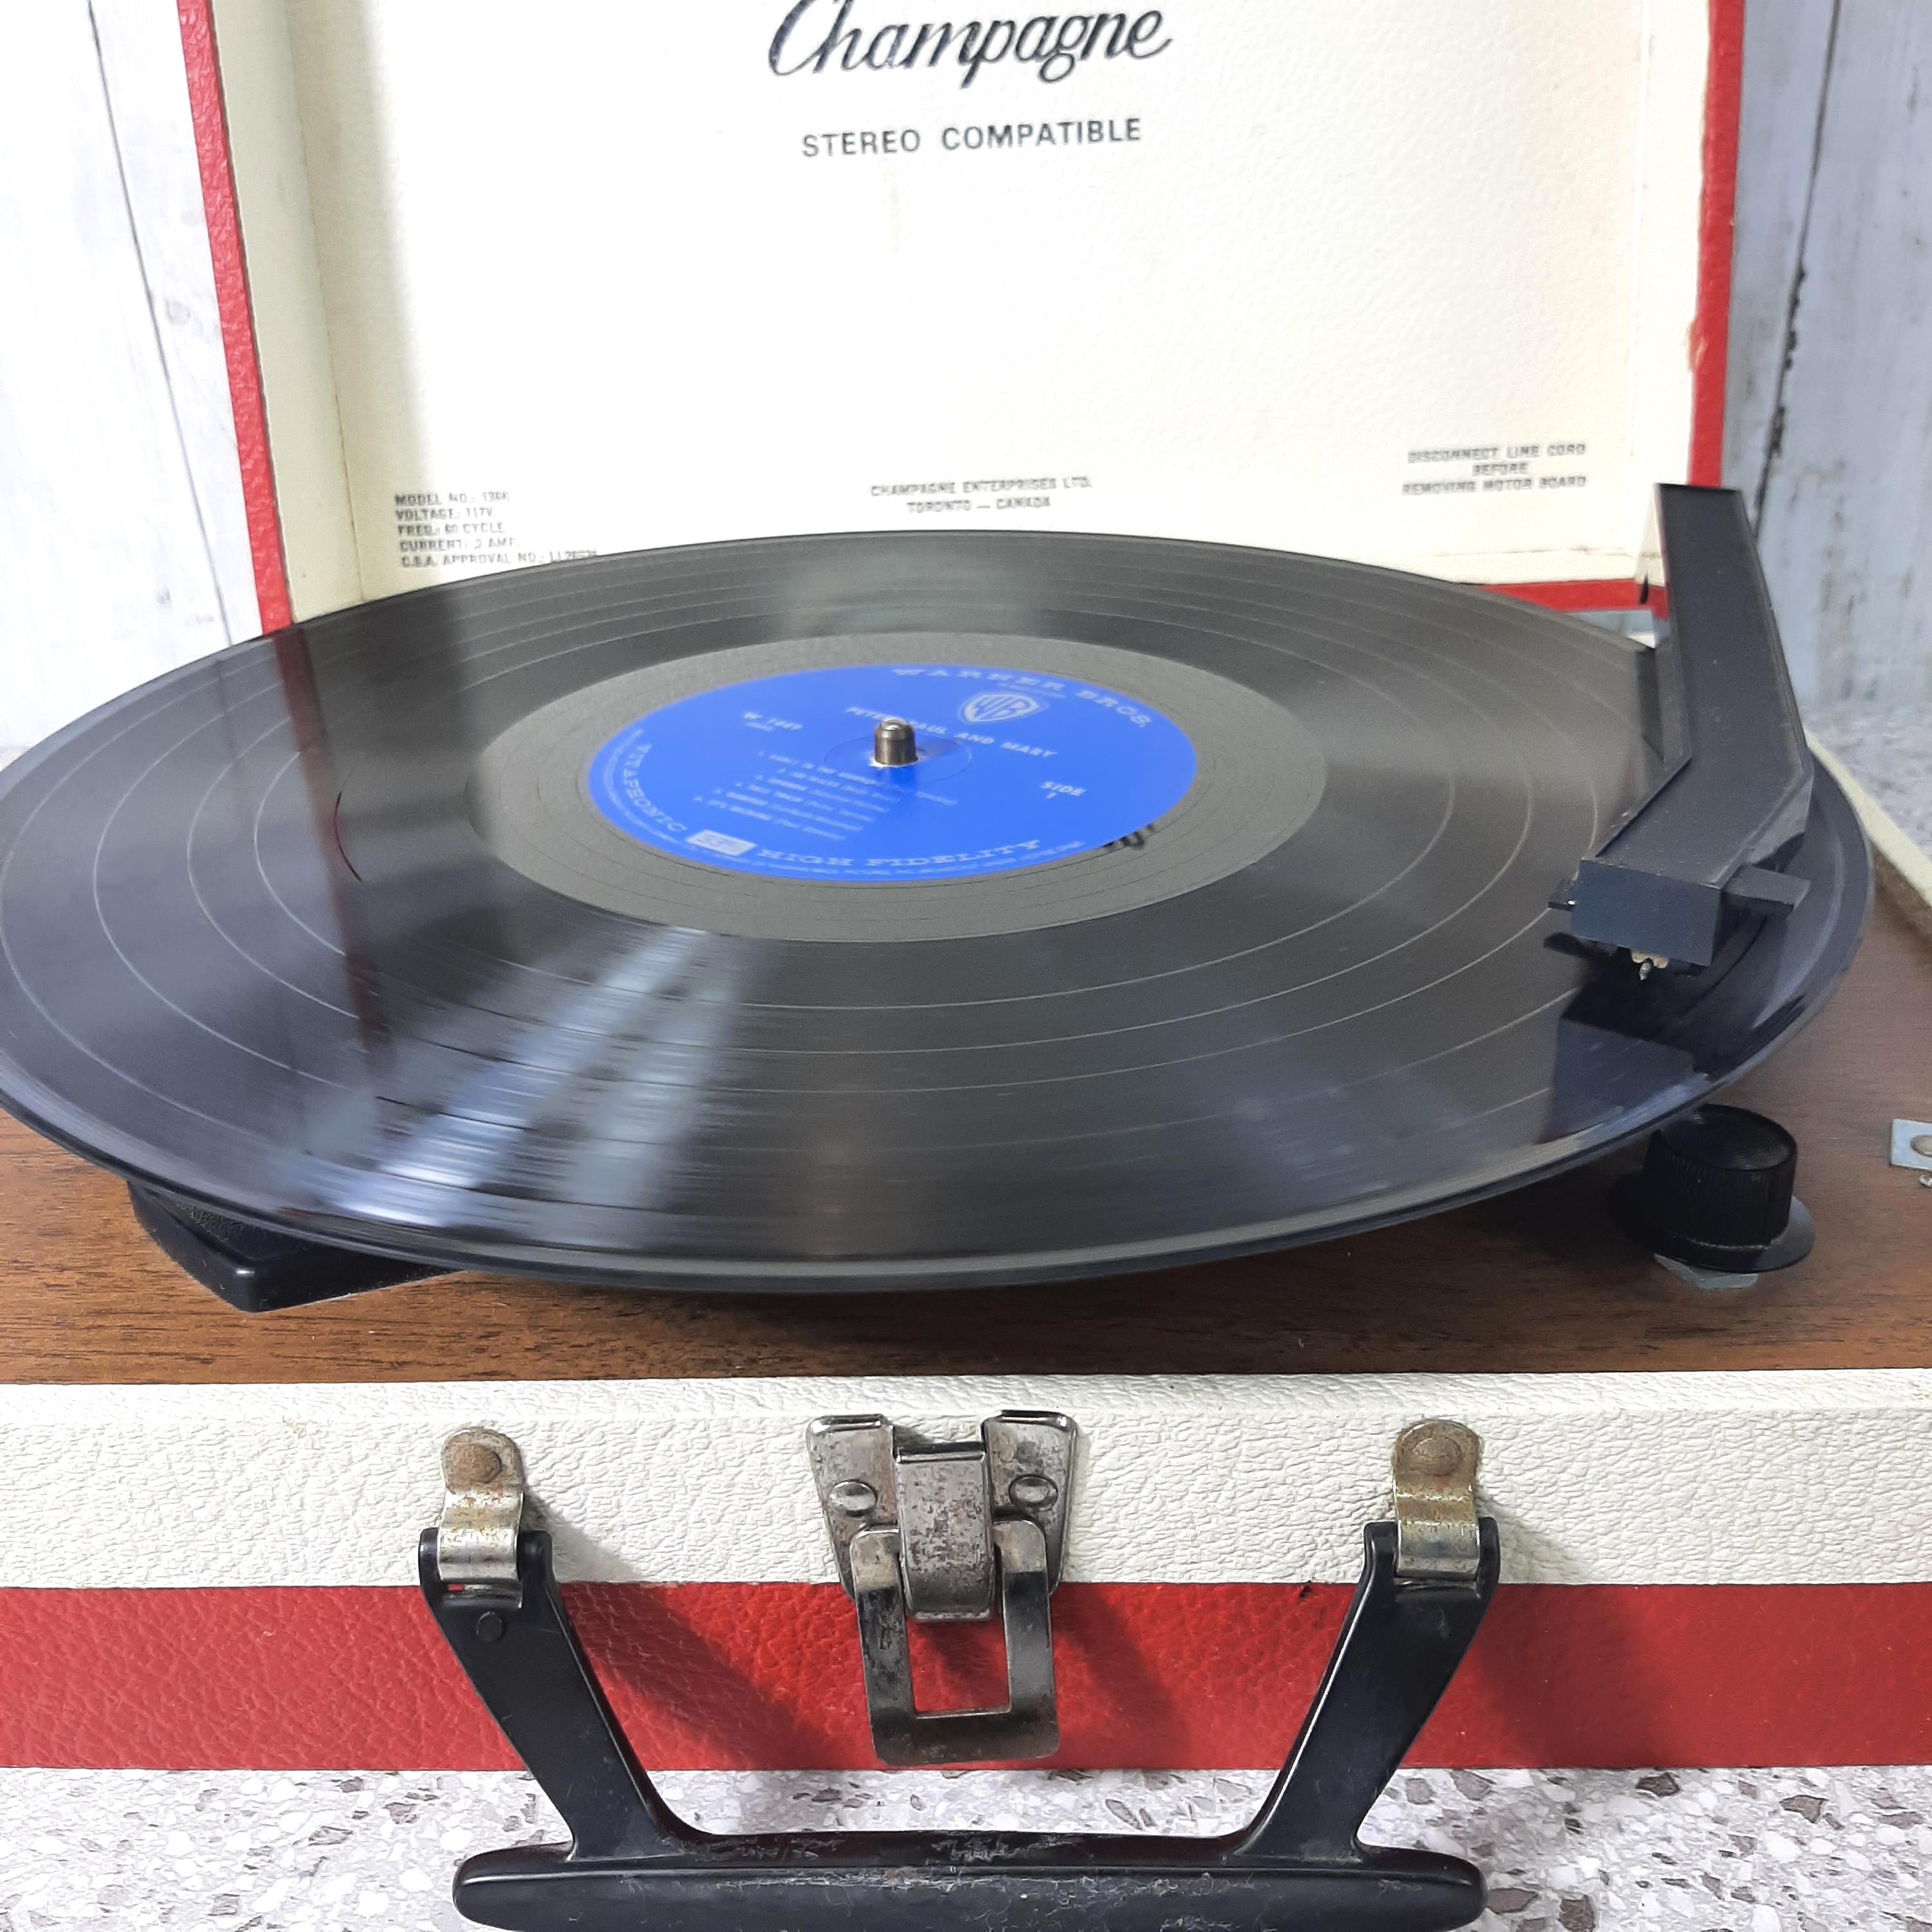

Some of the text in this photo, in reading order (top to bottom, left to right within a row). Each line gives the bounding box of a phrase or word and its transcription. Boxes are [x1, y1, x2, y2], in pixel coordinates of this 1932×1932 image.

[768, 0, 1172, 89] Champagne
[802, 118, 1142, 158] STEREO COMPATIBLE
[1408, 447, 1498, 464] DISCONNECT
[1547, 442, 1586, 457] CORD
[1473, 462, 1528, 477] BEFORE
[1402, 476, 1586, 495] REMOVING MOTOR BOARD
[394, 493, 442, 507] MODEL
[463, 522, 506, 534] CYCLE
[443, 552, 511, 565] APPROVAL
[892, 668, 1066, 690] WARNER
[952, 732, 995, 745] AND
[999, 741, 1057, 758] MARY
[1039, 780, 1088, 797] SIDE
[756, 849, 855, 867] HIGH
[864, 839, 1040, 867] FIDELITY
